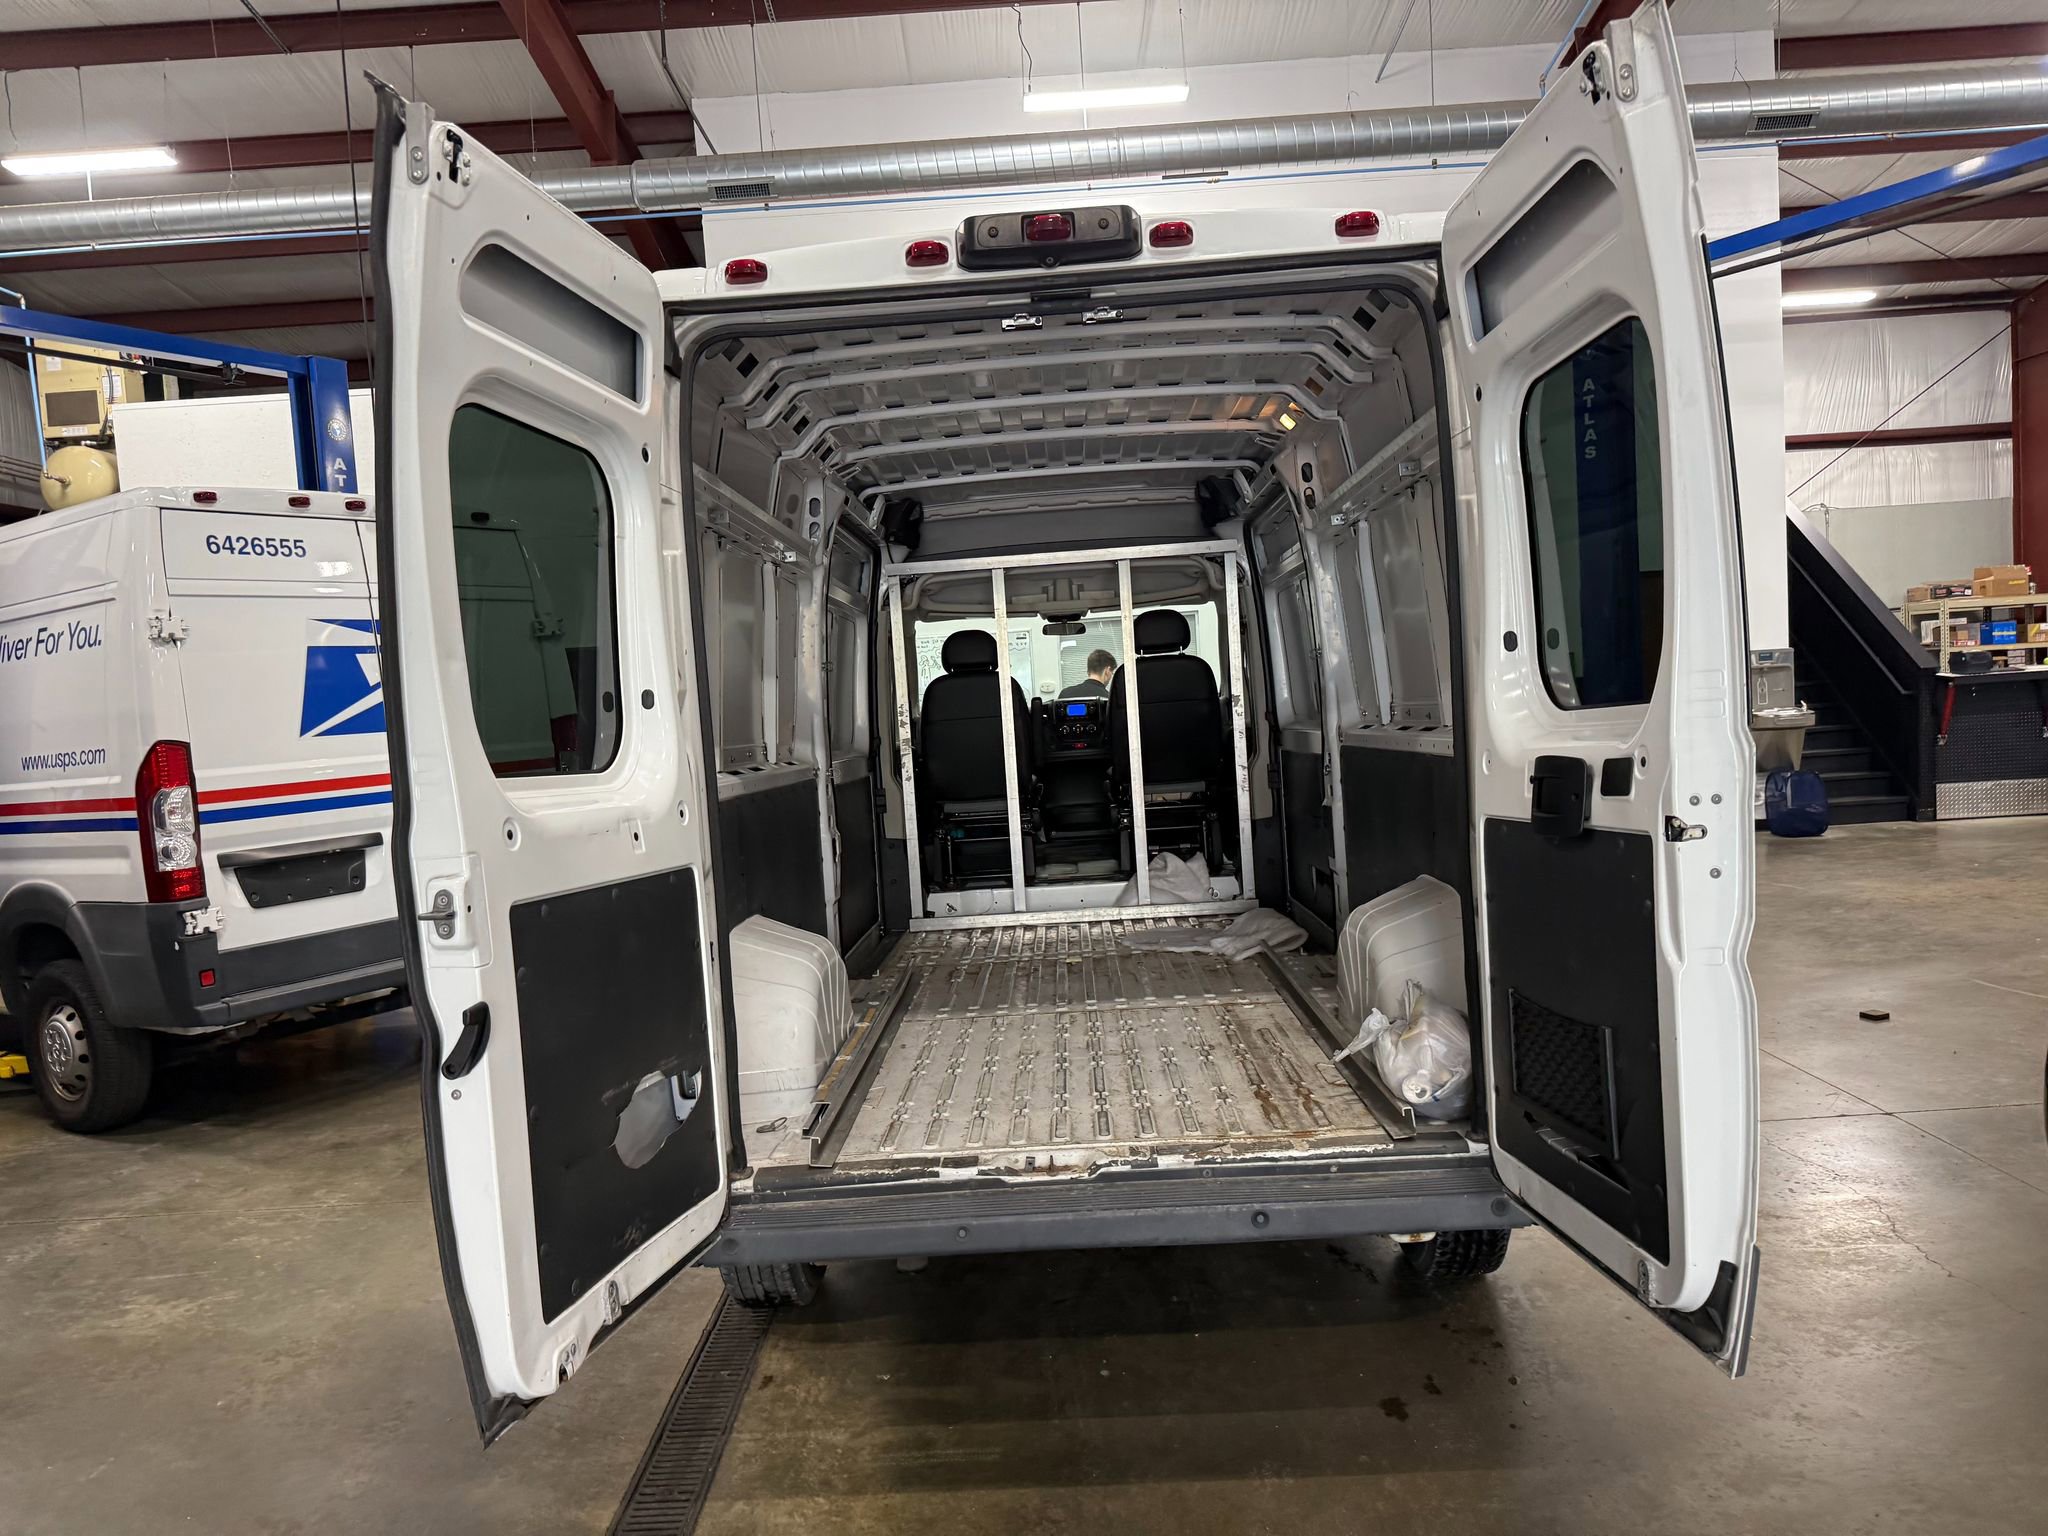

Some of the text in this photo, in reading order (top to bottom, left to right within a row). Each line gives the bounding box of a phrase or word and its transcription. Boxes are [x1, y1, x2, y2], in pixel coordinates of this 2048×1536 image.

[1582, 378, 1598, 459] ATLAS
[205, 534, 307, 558] 6426555
[34, 626, 65, 656] For
[67, 620, 102, 652] You.
[21, 748, 106, 773] www.usps.com
